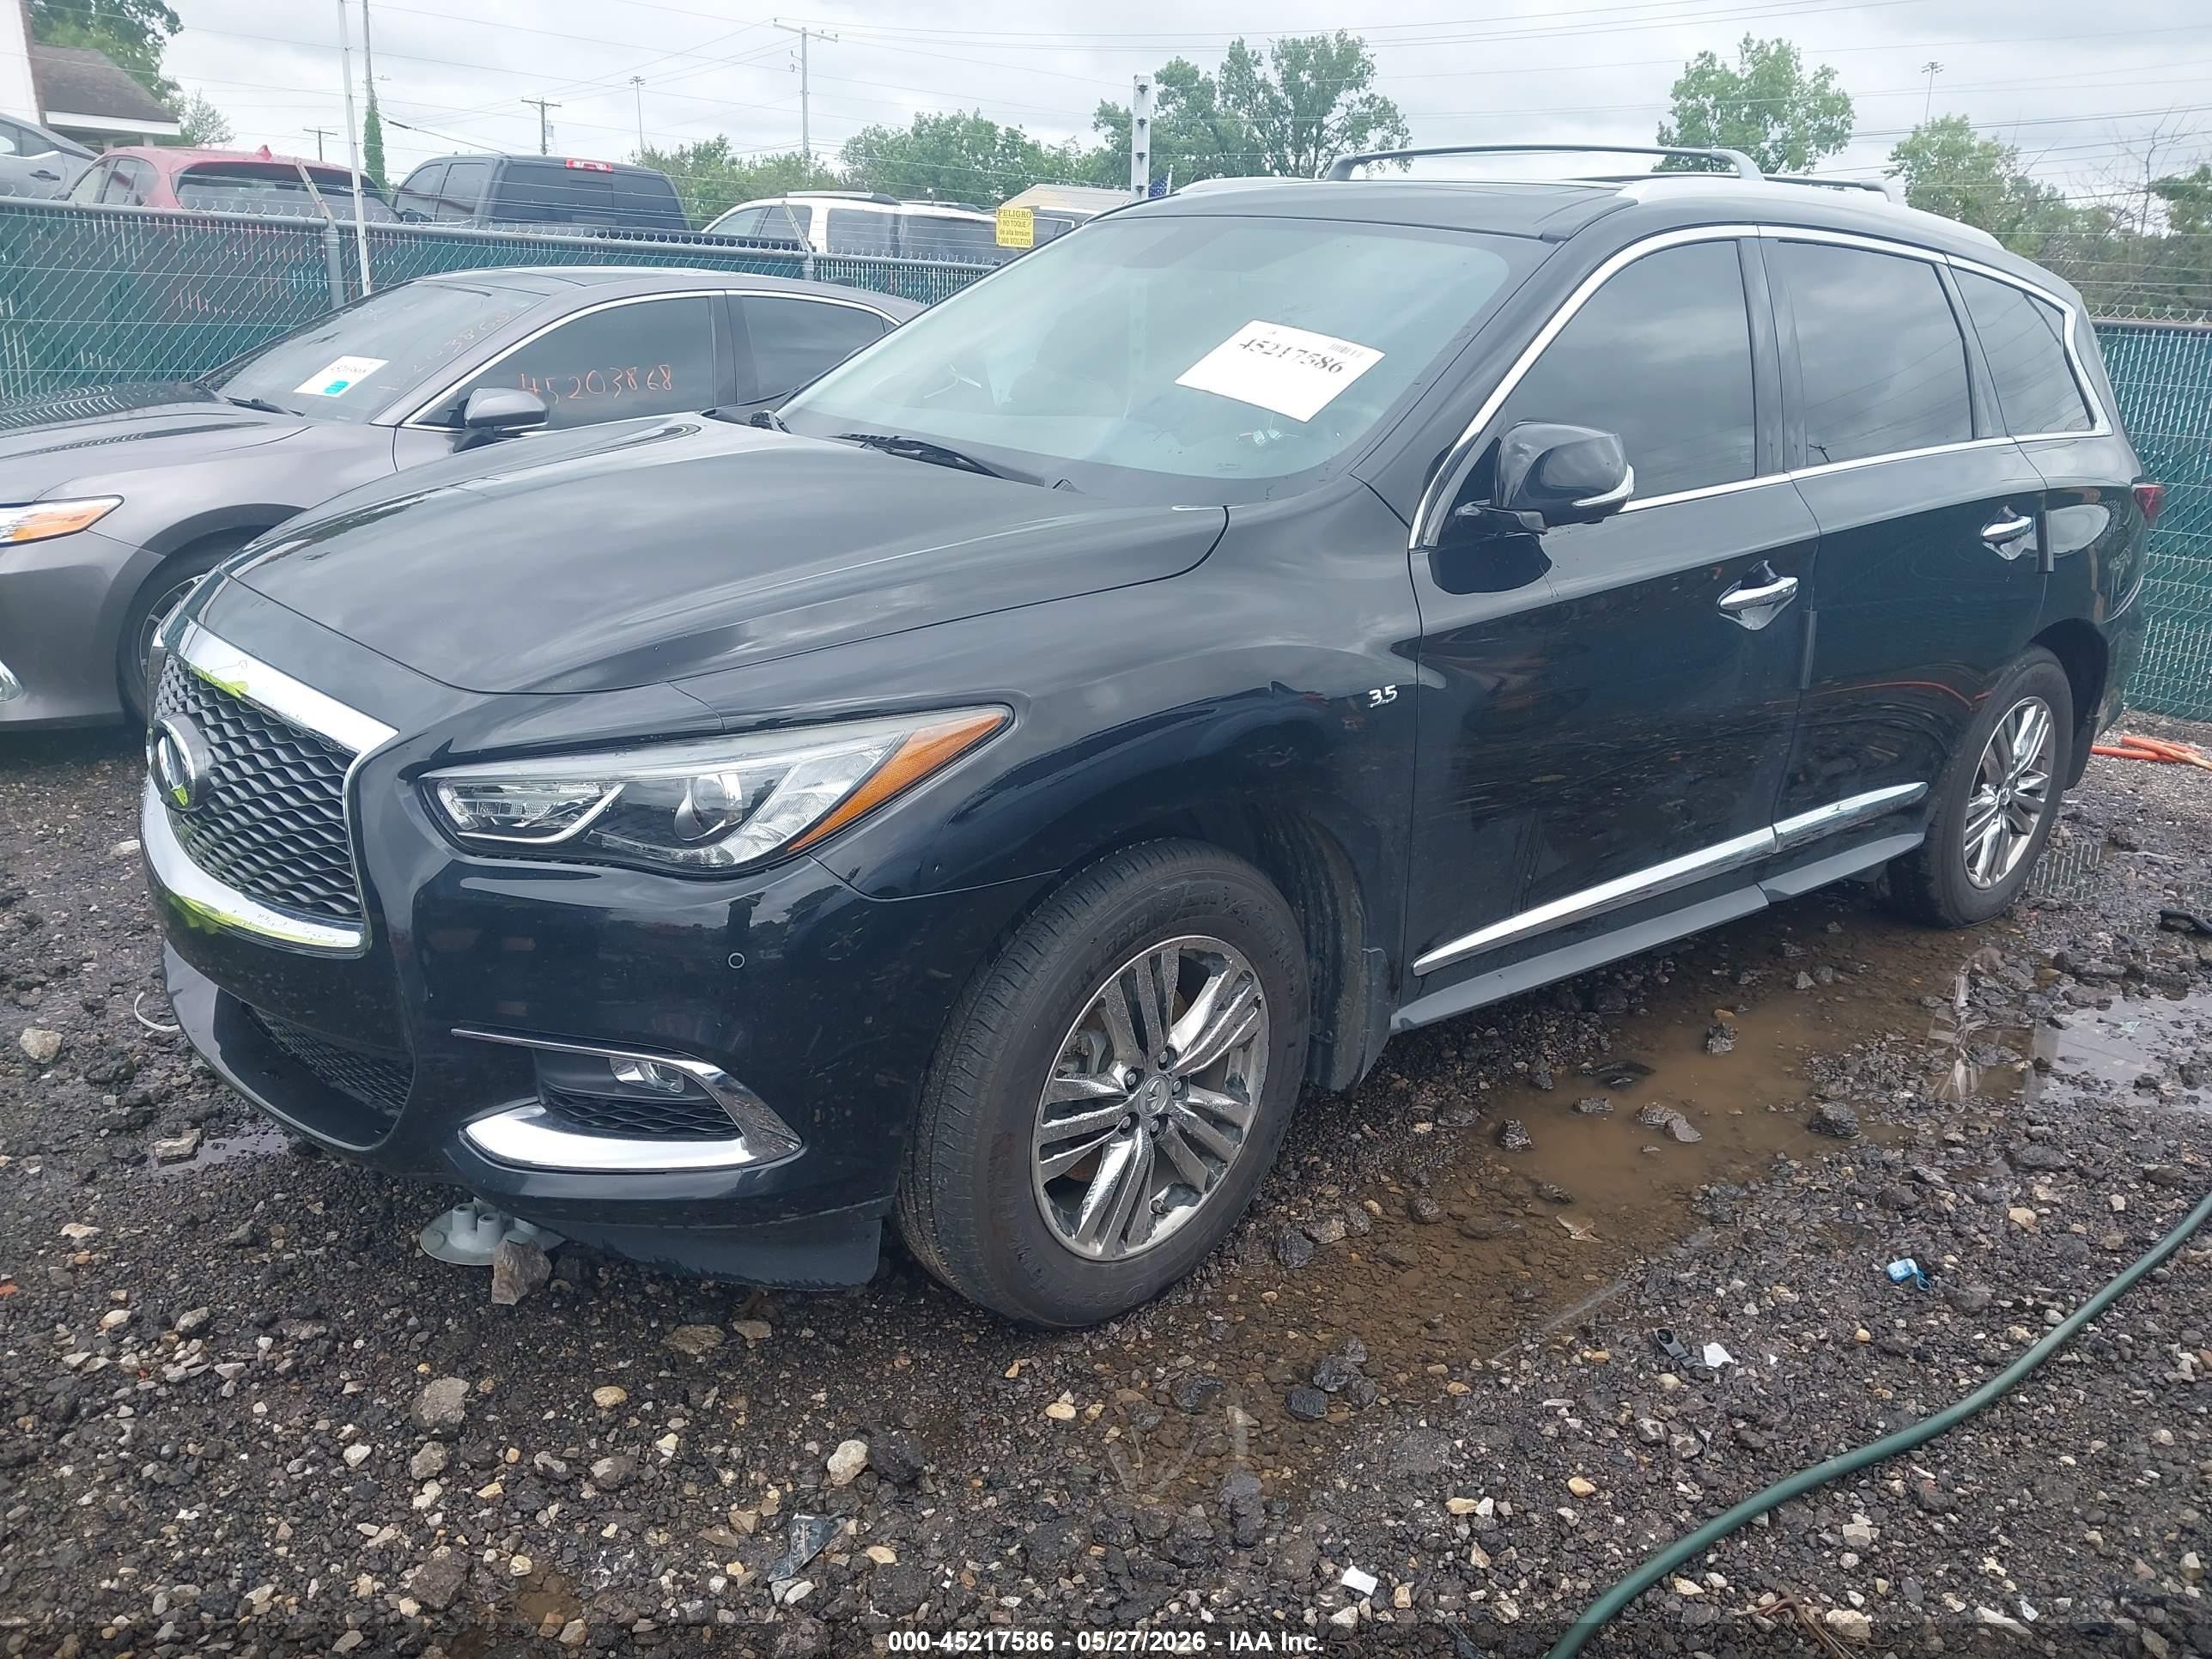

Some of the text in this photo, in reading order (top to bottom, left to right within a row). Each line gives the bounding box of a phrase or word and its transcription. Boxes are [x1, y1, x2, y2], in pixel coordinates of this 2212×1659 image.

[999, 209, 1032, 219] PELIGRO
[1010, 237, 1031, 246] VOLTIOS
[1238, 337, 1346, 374] 45217586
[521, 364, 672, 405] 45203868
